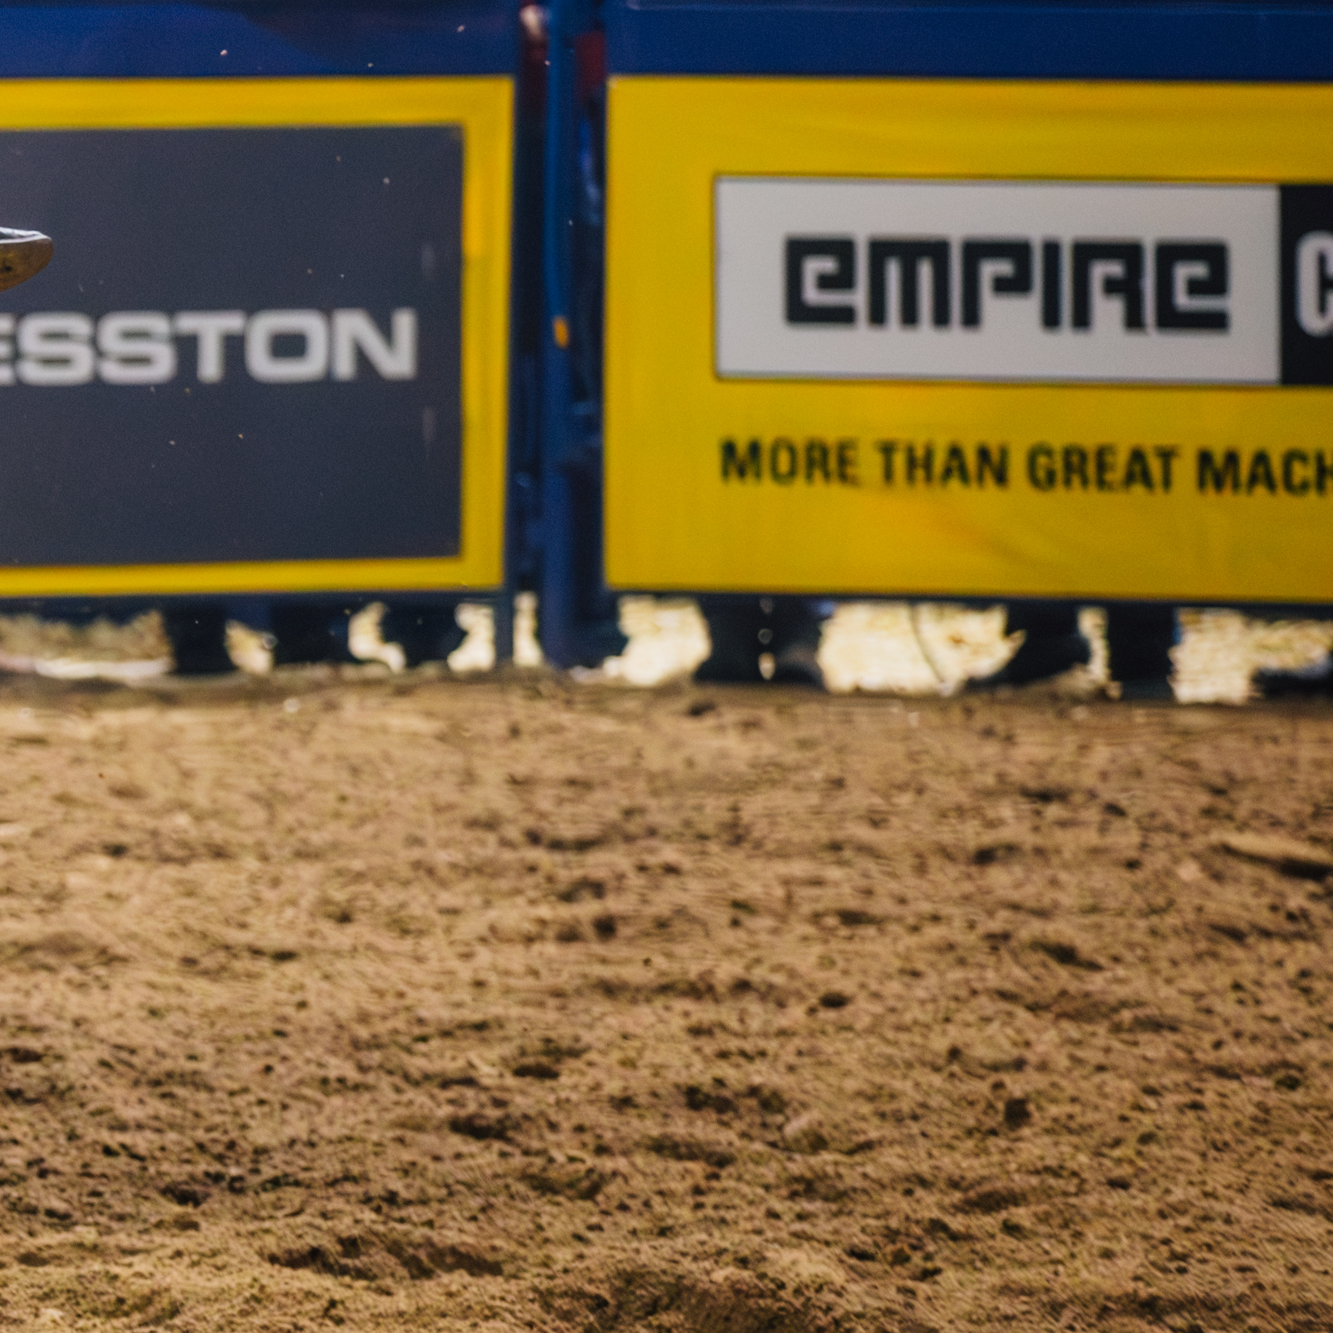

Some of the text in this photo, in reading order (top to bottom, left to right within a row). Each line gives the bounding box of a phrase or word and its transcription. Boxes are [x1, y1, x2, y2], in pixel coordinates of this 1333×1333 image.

[784, 235, 1231, 334] EMPIRE
[719, 436, 860, 486] MORE
[874, 439, 1011, 489] THAN
[1025, 442, 1182, 494] GREAT
